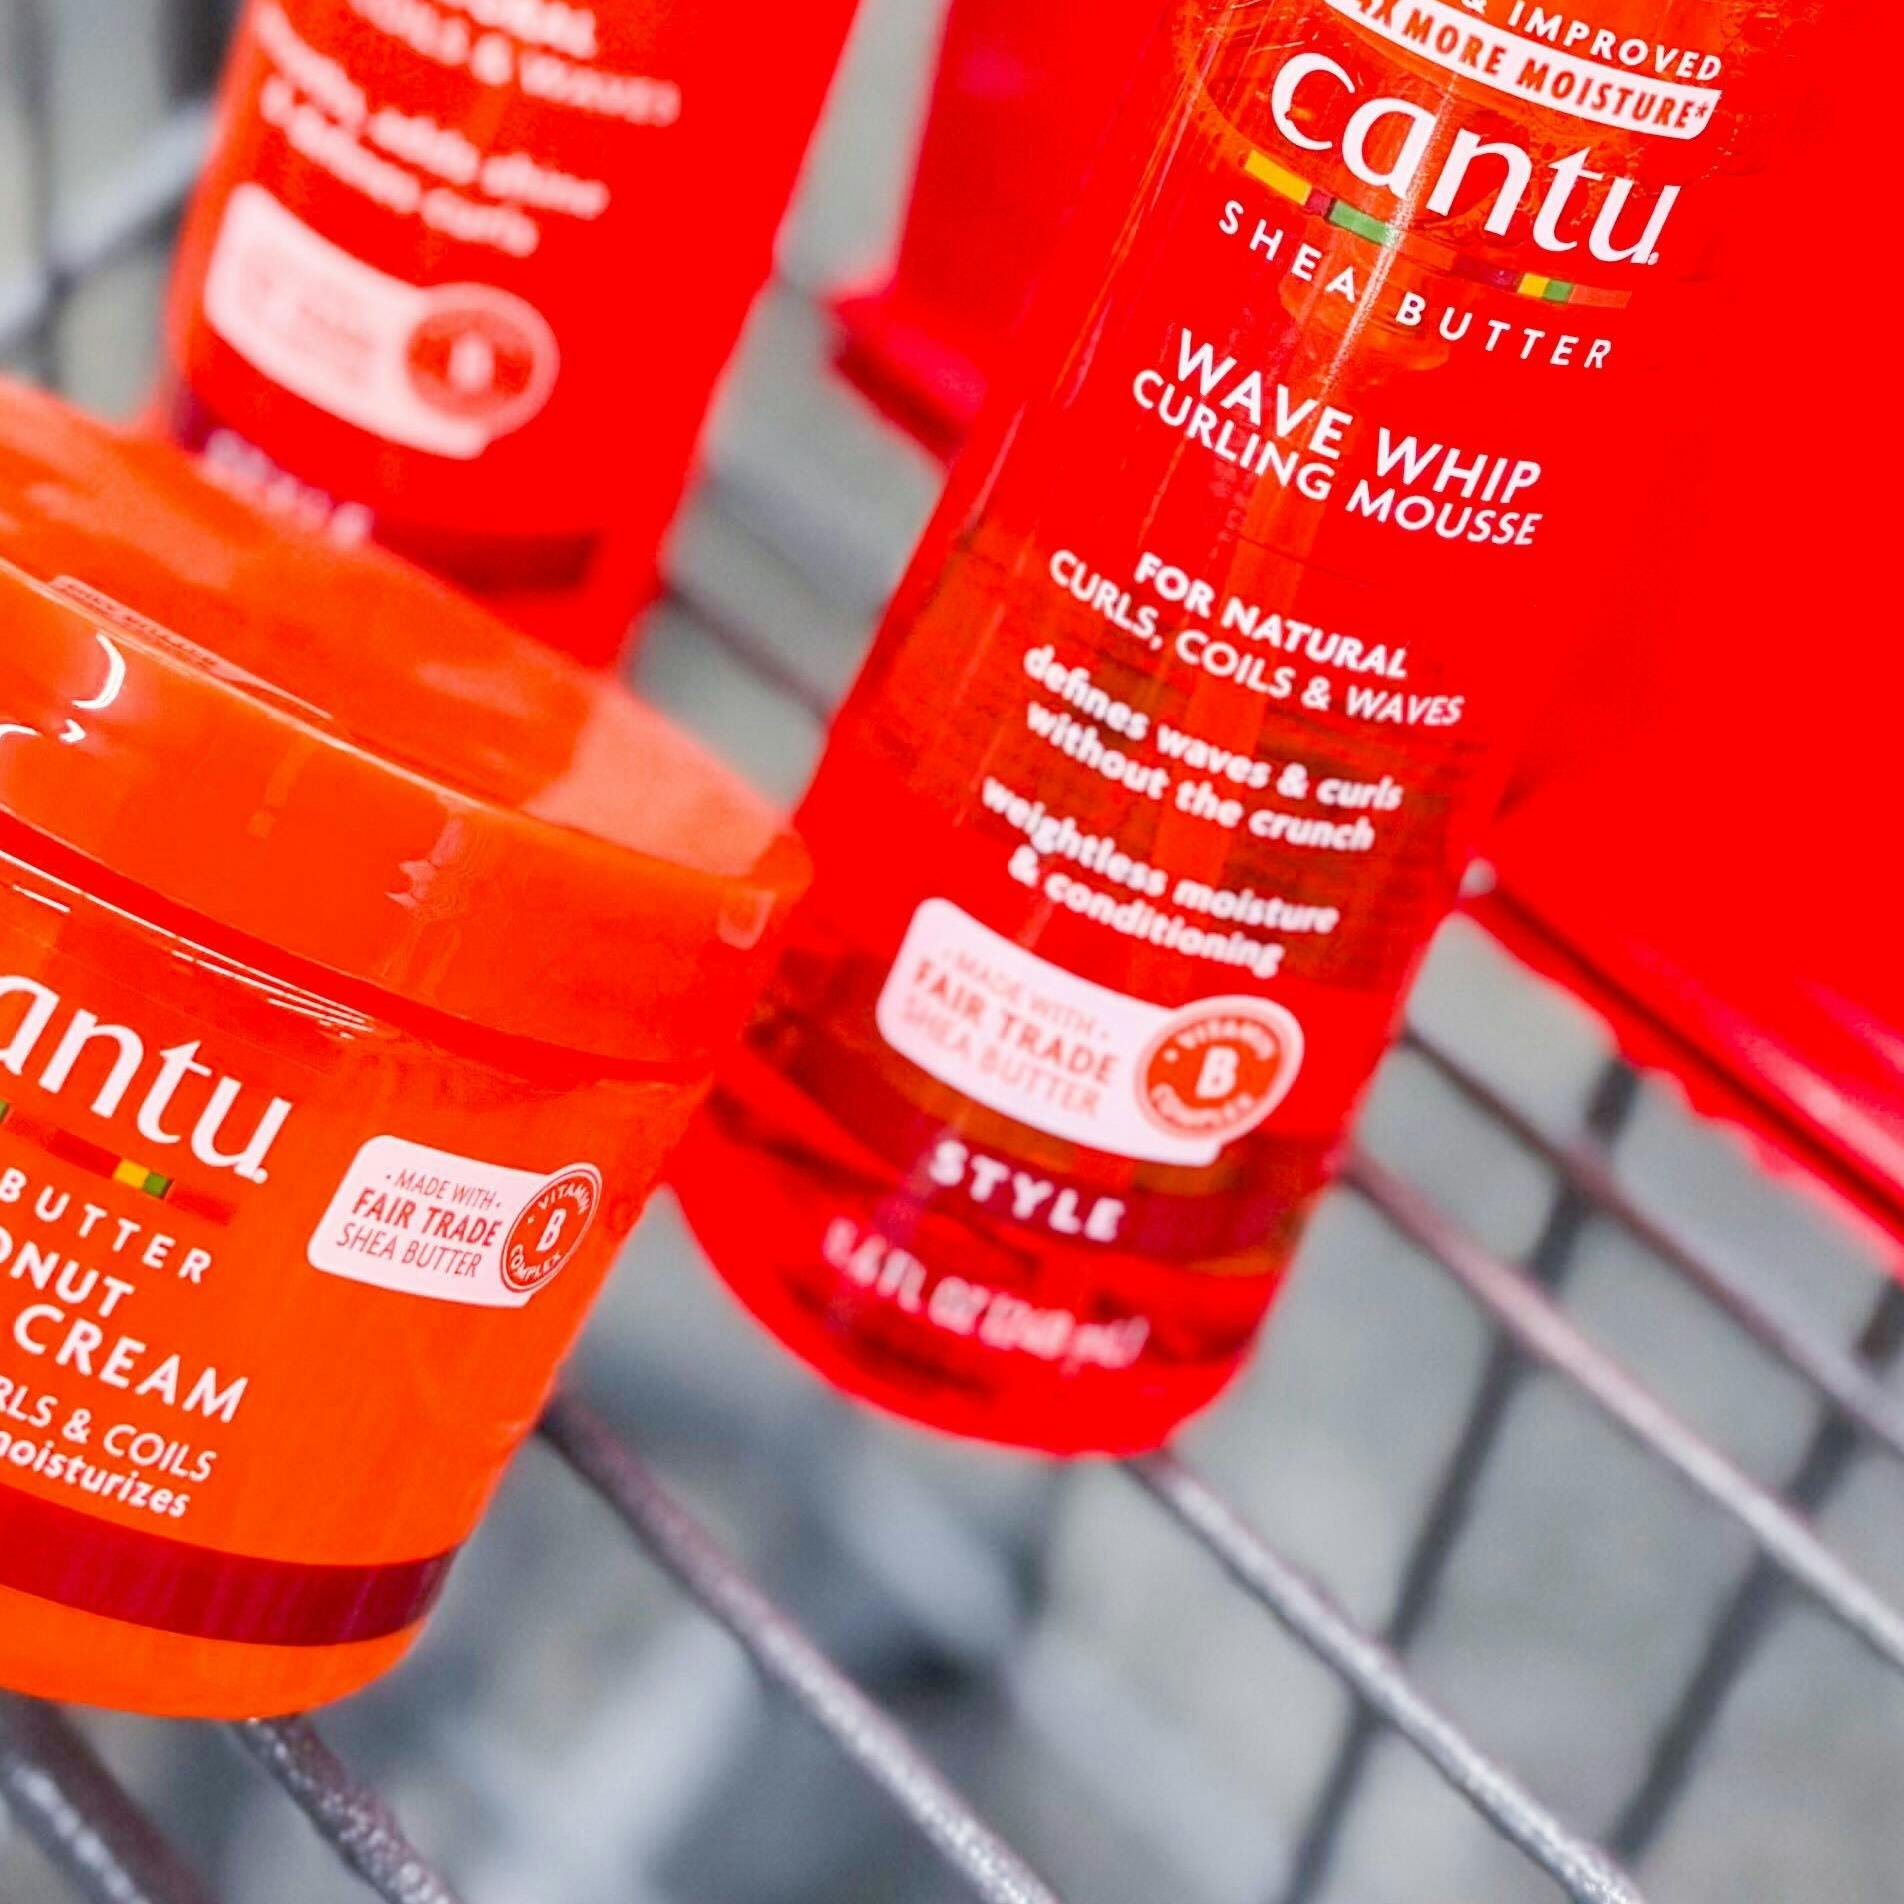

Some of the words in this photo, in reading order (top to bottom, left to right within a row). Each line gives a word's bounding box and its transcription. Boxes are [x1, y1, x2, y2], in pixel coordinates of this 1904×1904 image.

[1401, 8, 1507, 75] MORE
[1508, 0, 1722, 81] IMPROVED
[1271, 53, 1682, 266] cantu
[1218, 199, 1358, 303] SHEA
[1396, 292, 1613, 370] BUTTER
[1132, 369, 1335, 502] CURLING
[1345, 478, 1544, 547] MOUSSE
[1177, 328, 1354, 460] WAVE
[1375, 427, 1543, 505] WHIP
[1048, 549, 1164, 652] CURLS,
[1175, 628, 1295, 700] COILS
[1301, 675, 1332, 712] &
[1345, 683, 1466, 728] WAVES
[1133, 551, 1215, 618] FOR
[1219, 596, 1409, 681] NATURAL
[1023, 643, 1150, 741] defines
[1156, 724, 1271, 790] waves
[1275, 762, 1309, 801] &
[1316, 776, 1404, 812] curls
[1027, 701, 1171, 801] without
[1175, 780, 1244, 829] the
[1248, 809, 1376, 852] crunch
[982, 776, 1169, 897] weightless
[1172, 878, 1341, 935] moisture
[1008, 844, 1040, 887] &
[1043, 872, 1286, 981] conditioning
[912, 958, 987, 1028] FAIR
[999, 1010, 1119, 1086] TRADE
[1196, 1046, 1241, 1100] B
[336, 1223, 398, 1260] SHEA
[404, 1239, 483, 1279] BUTTER
[352, 1187, 414, 1230] FAIR
[427, 1206, 503, 1248] TRADE
[394, 1168, 446, 1201] MADE
[451, 1183, 495, 1210] WITH
[536, 1209, 568, 1253] B
[928, 1138, 1127, 1244] STYLE
[13, 1303, 249, 1424] CREAM
[62, 1408, 92, 1444] &
[103, 1424, 218, 1483] COILS
